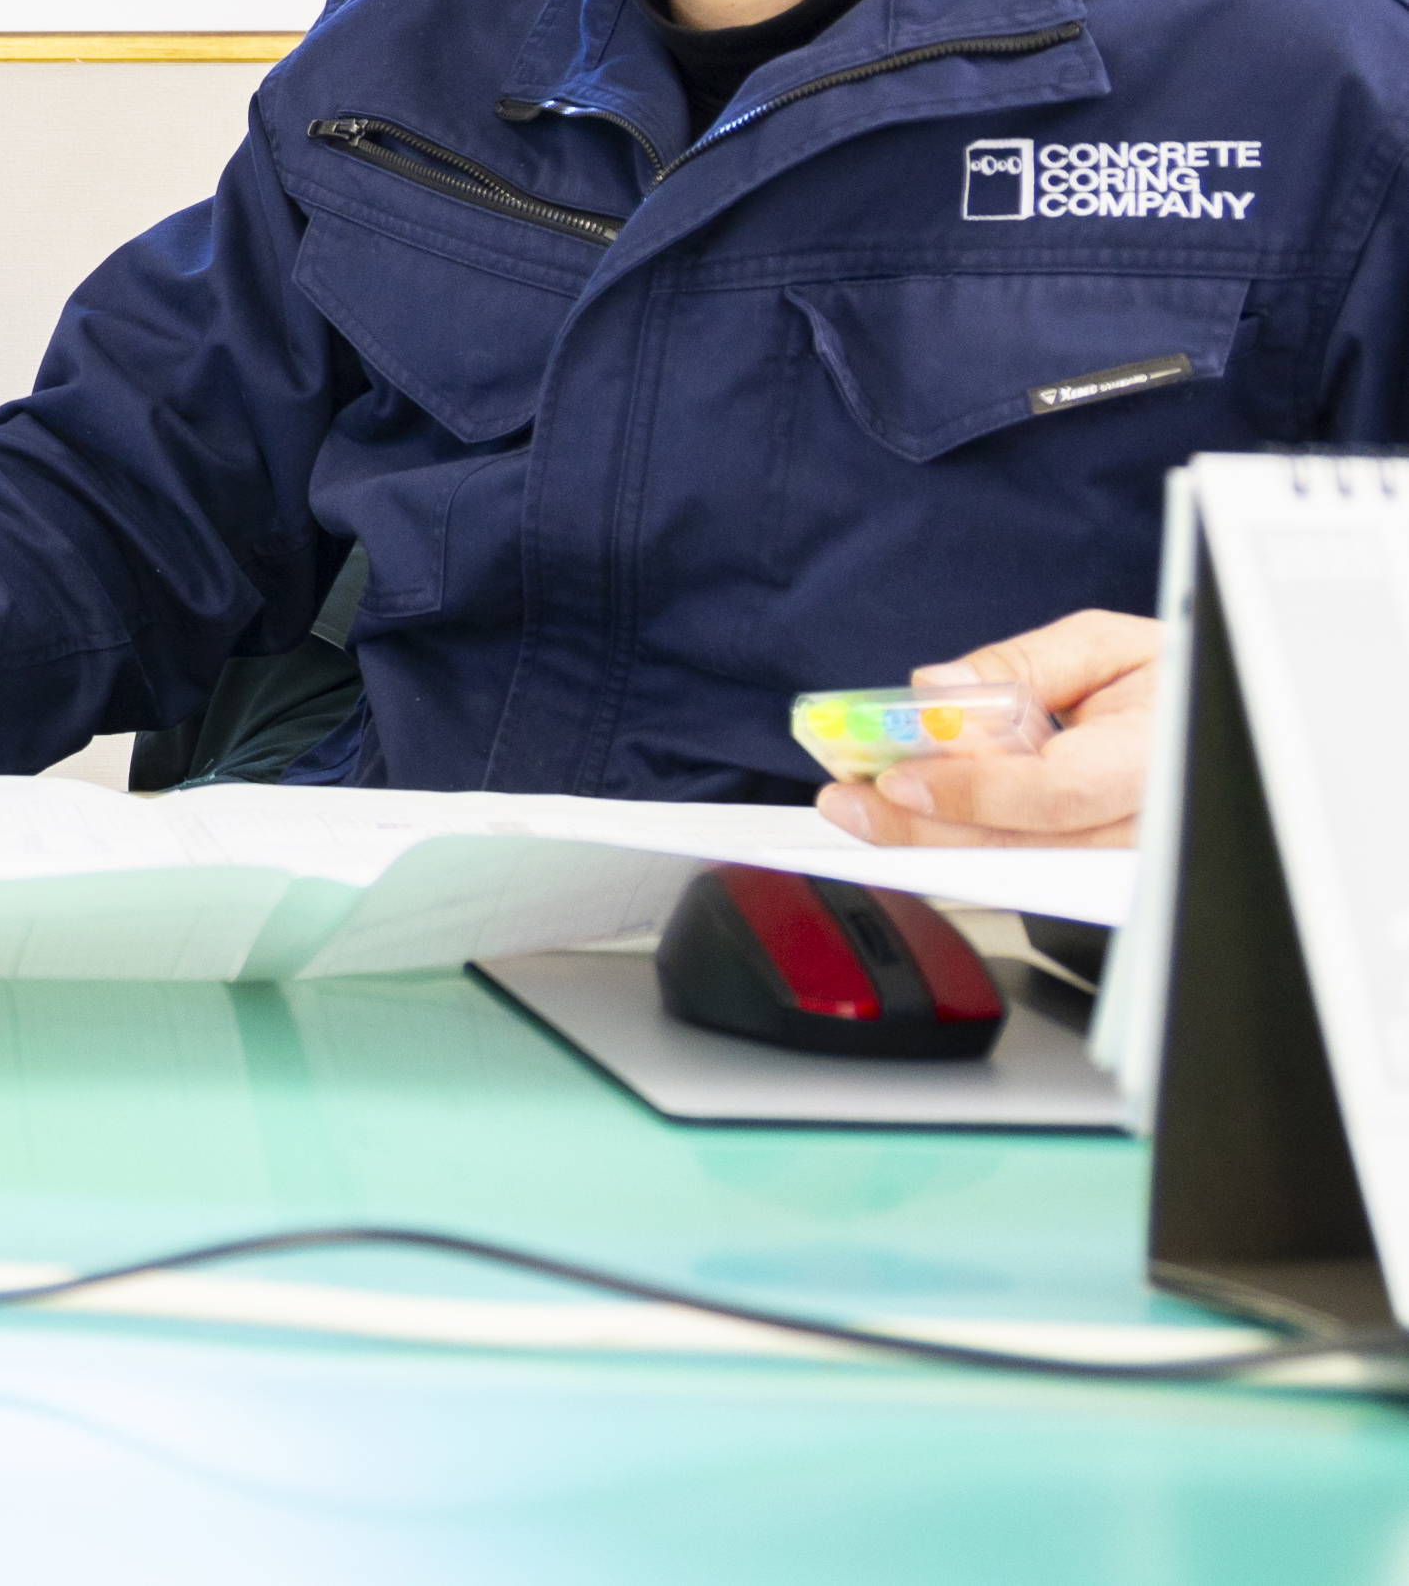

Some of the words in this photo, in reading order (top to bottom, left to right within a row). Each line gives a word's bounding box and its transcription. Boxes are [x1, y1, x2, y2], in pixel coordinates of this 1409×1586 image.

[1040, 141, 1261, 168] CONCRETE
[1040, 167, 1201, 193] CORING
[1039, 192, 1255, 219] COMPANY
